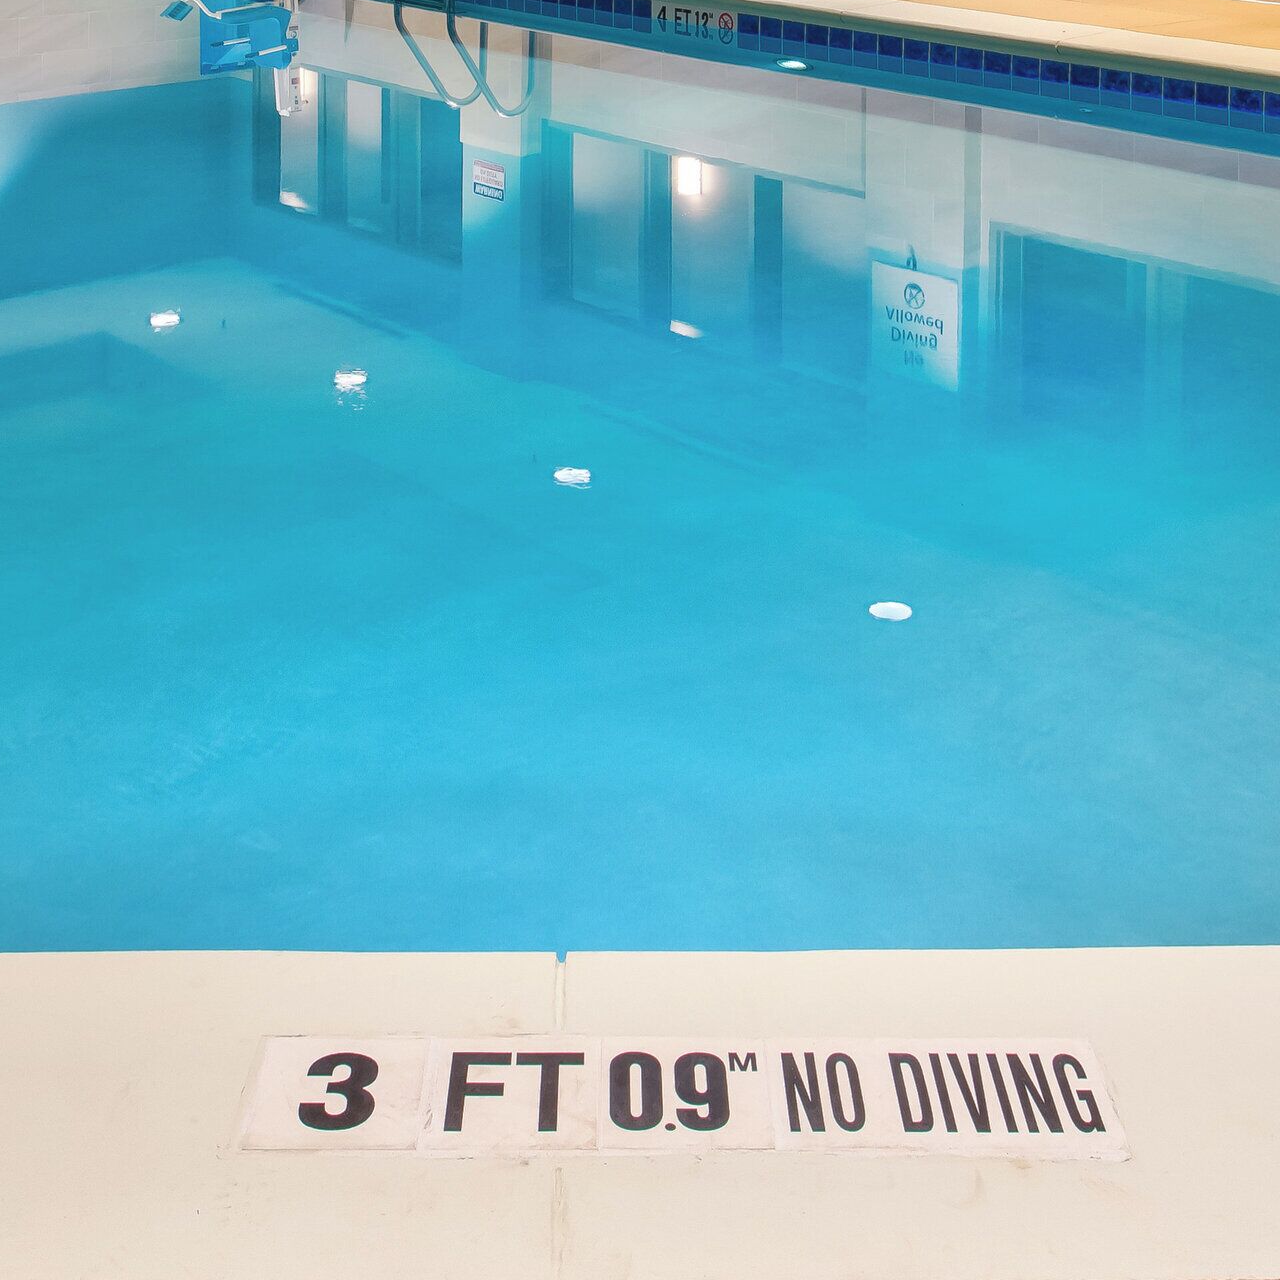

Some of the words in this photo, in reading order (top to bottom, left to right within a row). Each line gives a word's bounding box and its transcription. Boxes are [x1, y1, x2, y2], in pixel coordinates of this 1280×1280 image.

[657, 6, 667, 20] 4
[299, 1051, 381, 1132] 3
[444, 1051, 585, 1132] FT
[783, 1051, 867, 1133] NO
[887, 1051, 1107, 1133] DIVING
